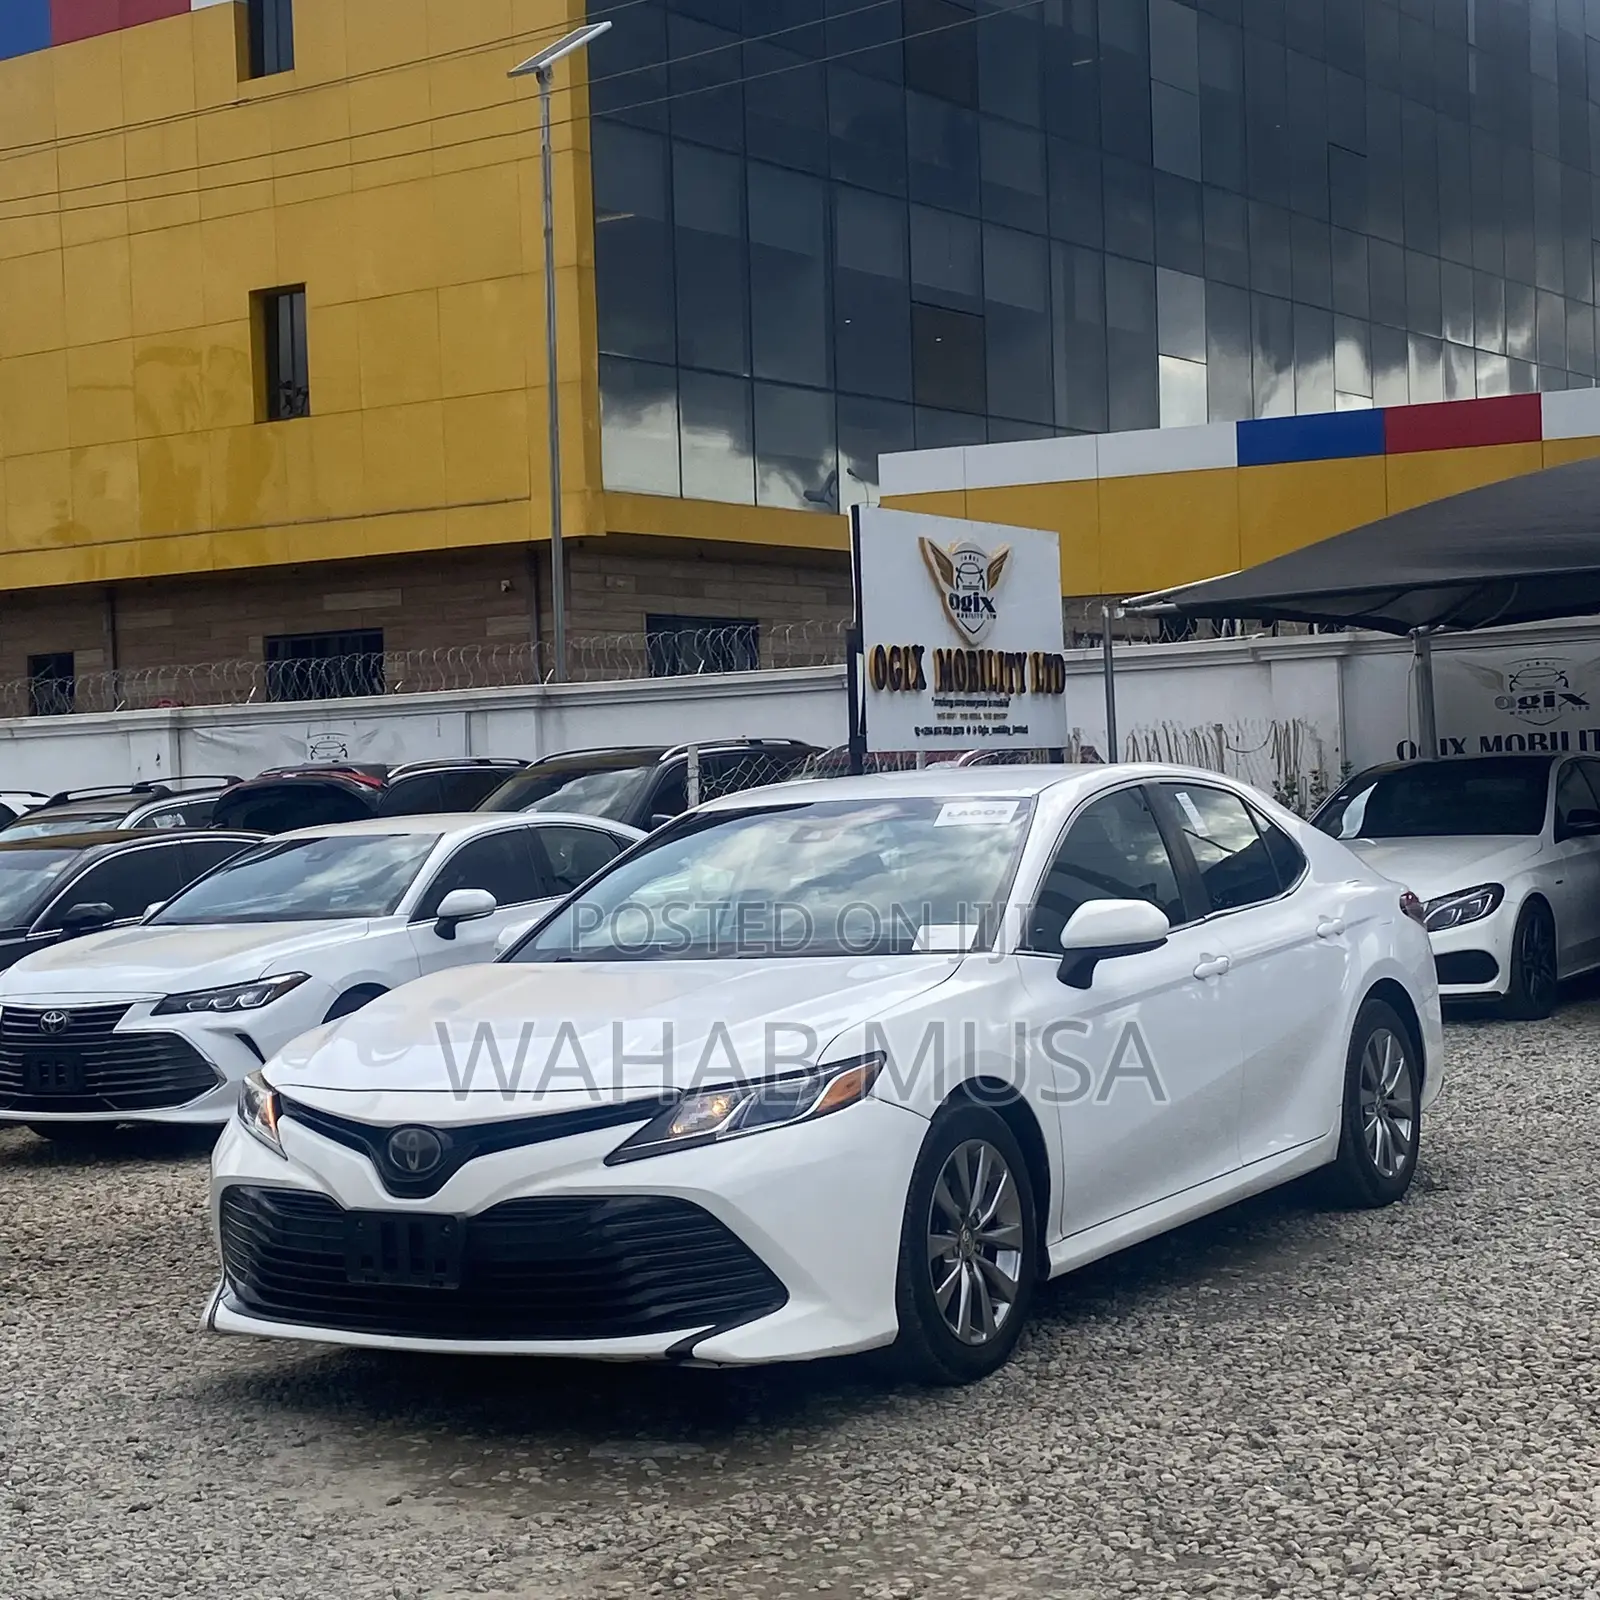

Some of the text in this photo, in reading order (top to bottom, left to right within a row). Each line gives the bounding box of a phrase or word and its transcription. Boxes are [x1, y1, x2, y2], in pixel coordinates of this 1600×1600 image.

[869, 643, 1067, 695] OGIX MOBILITY LTD
[1396, 737, 1467, 761] OIX
[946, 809, 1009, 818] LAGOS
